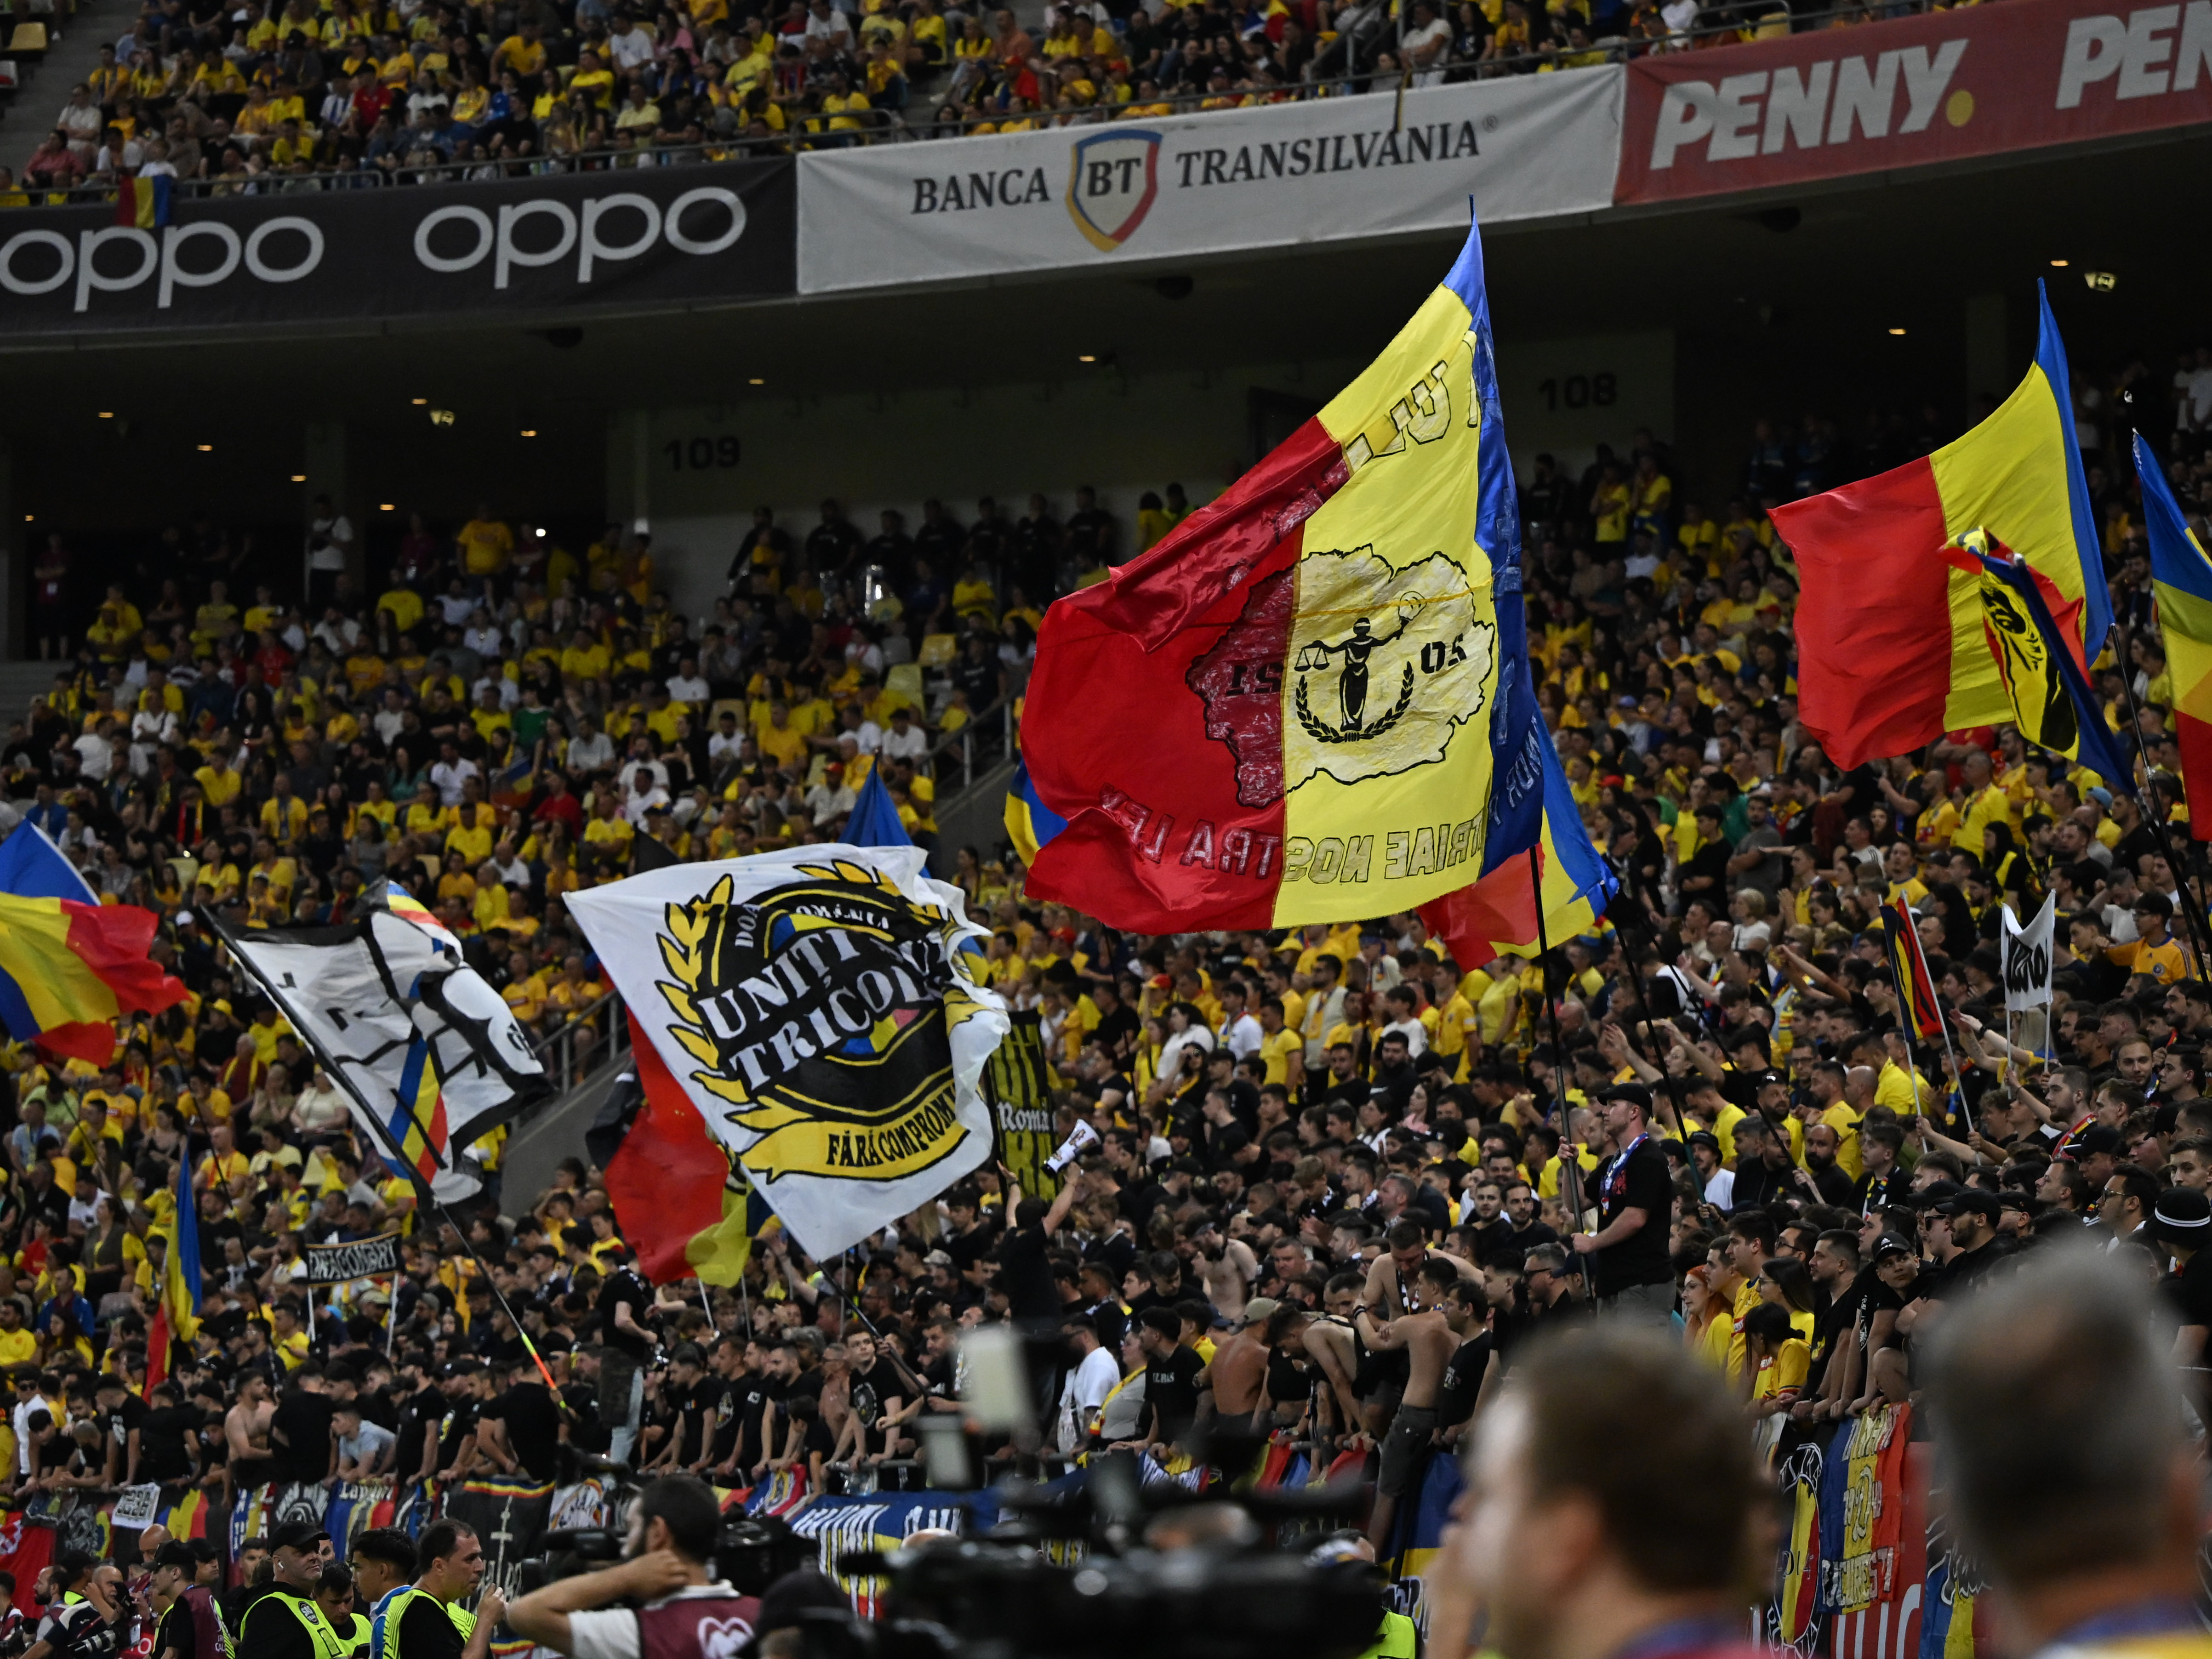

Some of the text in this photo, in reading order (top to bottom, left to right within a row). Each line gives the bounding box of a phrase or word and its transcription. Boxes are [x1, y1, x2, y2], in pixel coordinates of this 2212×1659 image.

[2056, 0, 2212, 109] PEN
[911, 166, 1050, 215] BANCA
[1086, 157, 1141, 197] BT
[0, 216, 325, 313] oppo
[414, 186, 747, 290] oppo
[1539, 373, 1617, 411] 108
[663, 436, 741, 472] 109
[729, 965, 943, 1091] TRICOL
